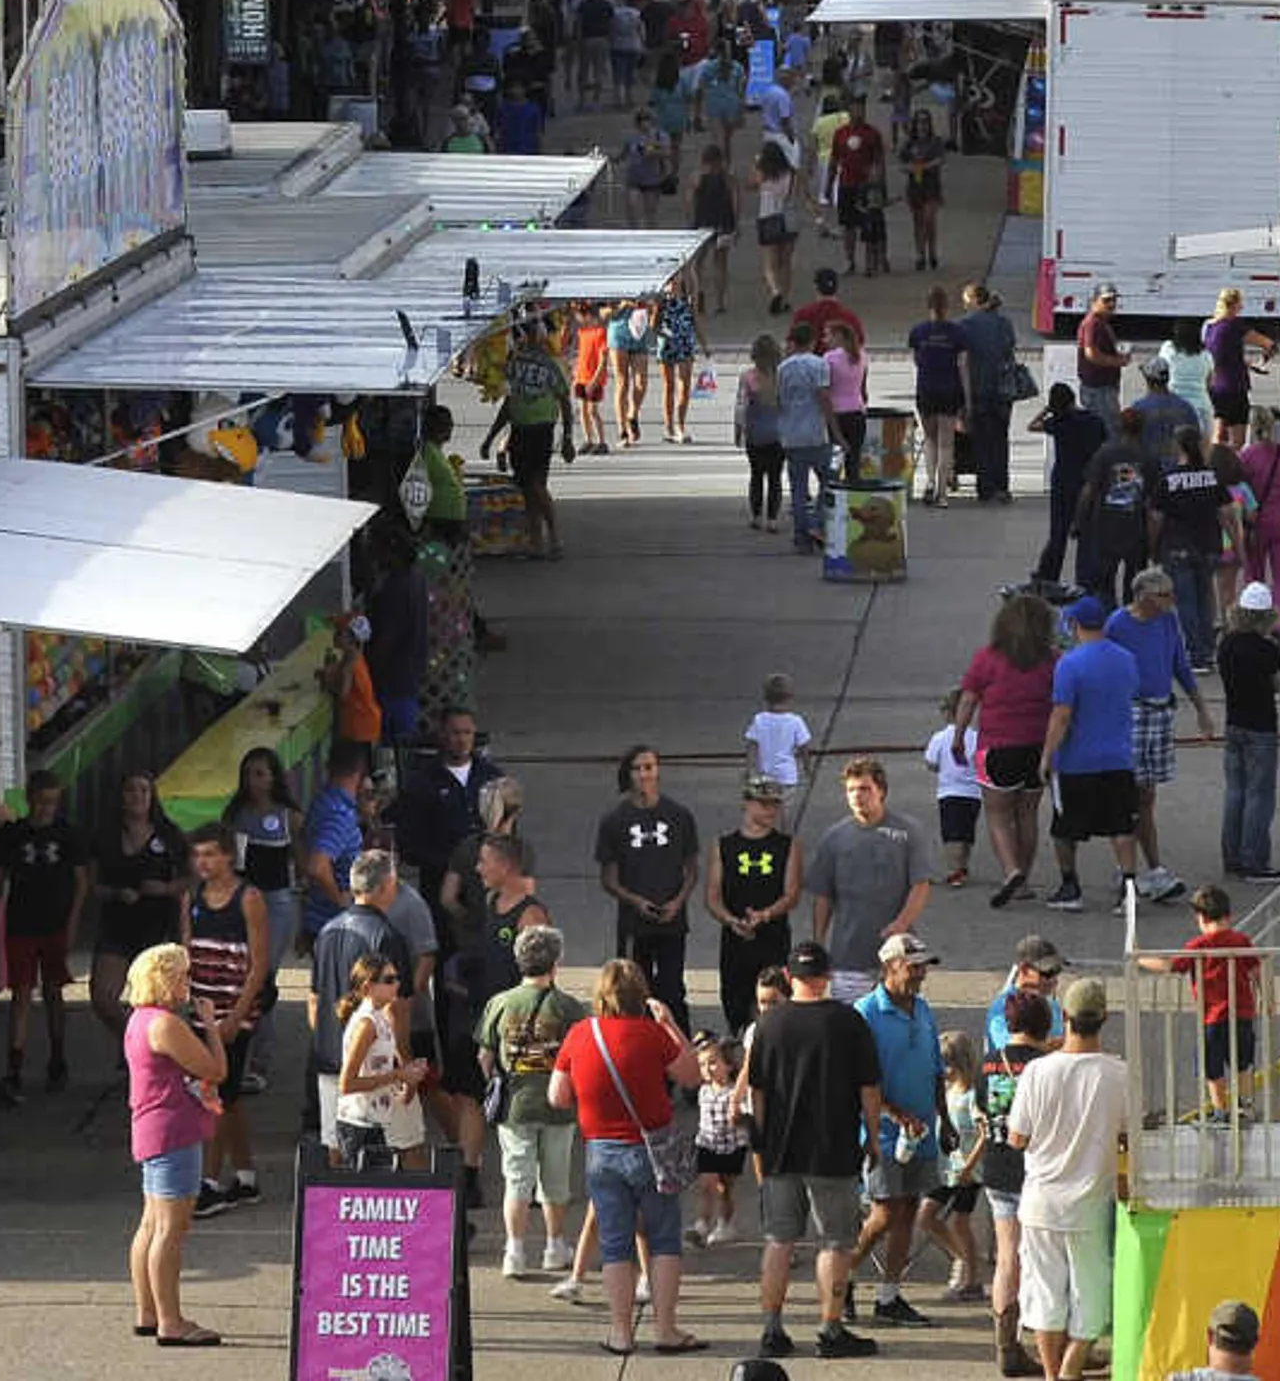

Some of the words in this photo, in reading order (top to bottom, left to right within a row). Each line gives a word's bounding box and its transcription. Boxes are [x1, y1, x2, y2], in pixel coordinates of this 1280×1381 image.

[339, 1195, 419, 1222] FAMILY
[348, 1234, 403, 1261] TIME
[341, 1272, 363, 1298] IS
[367, 1273, 410, 1299] THE
[317, 1310, 372, 1337] BEST
[375, 1312, 432, 1338] TIME
